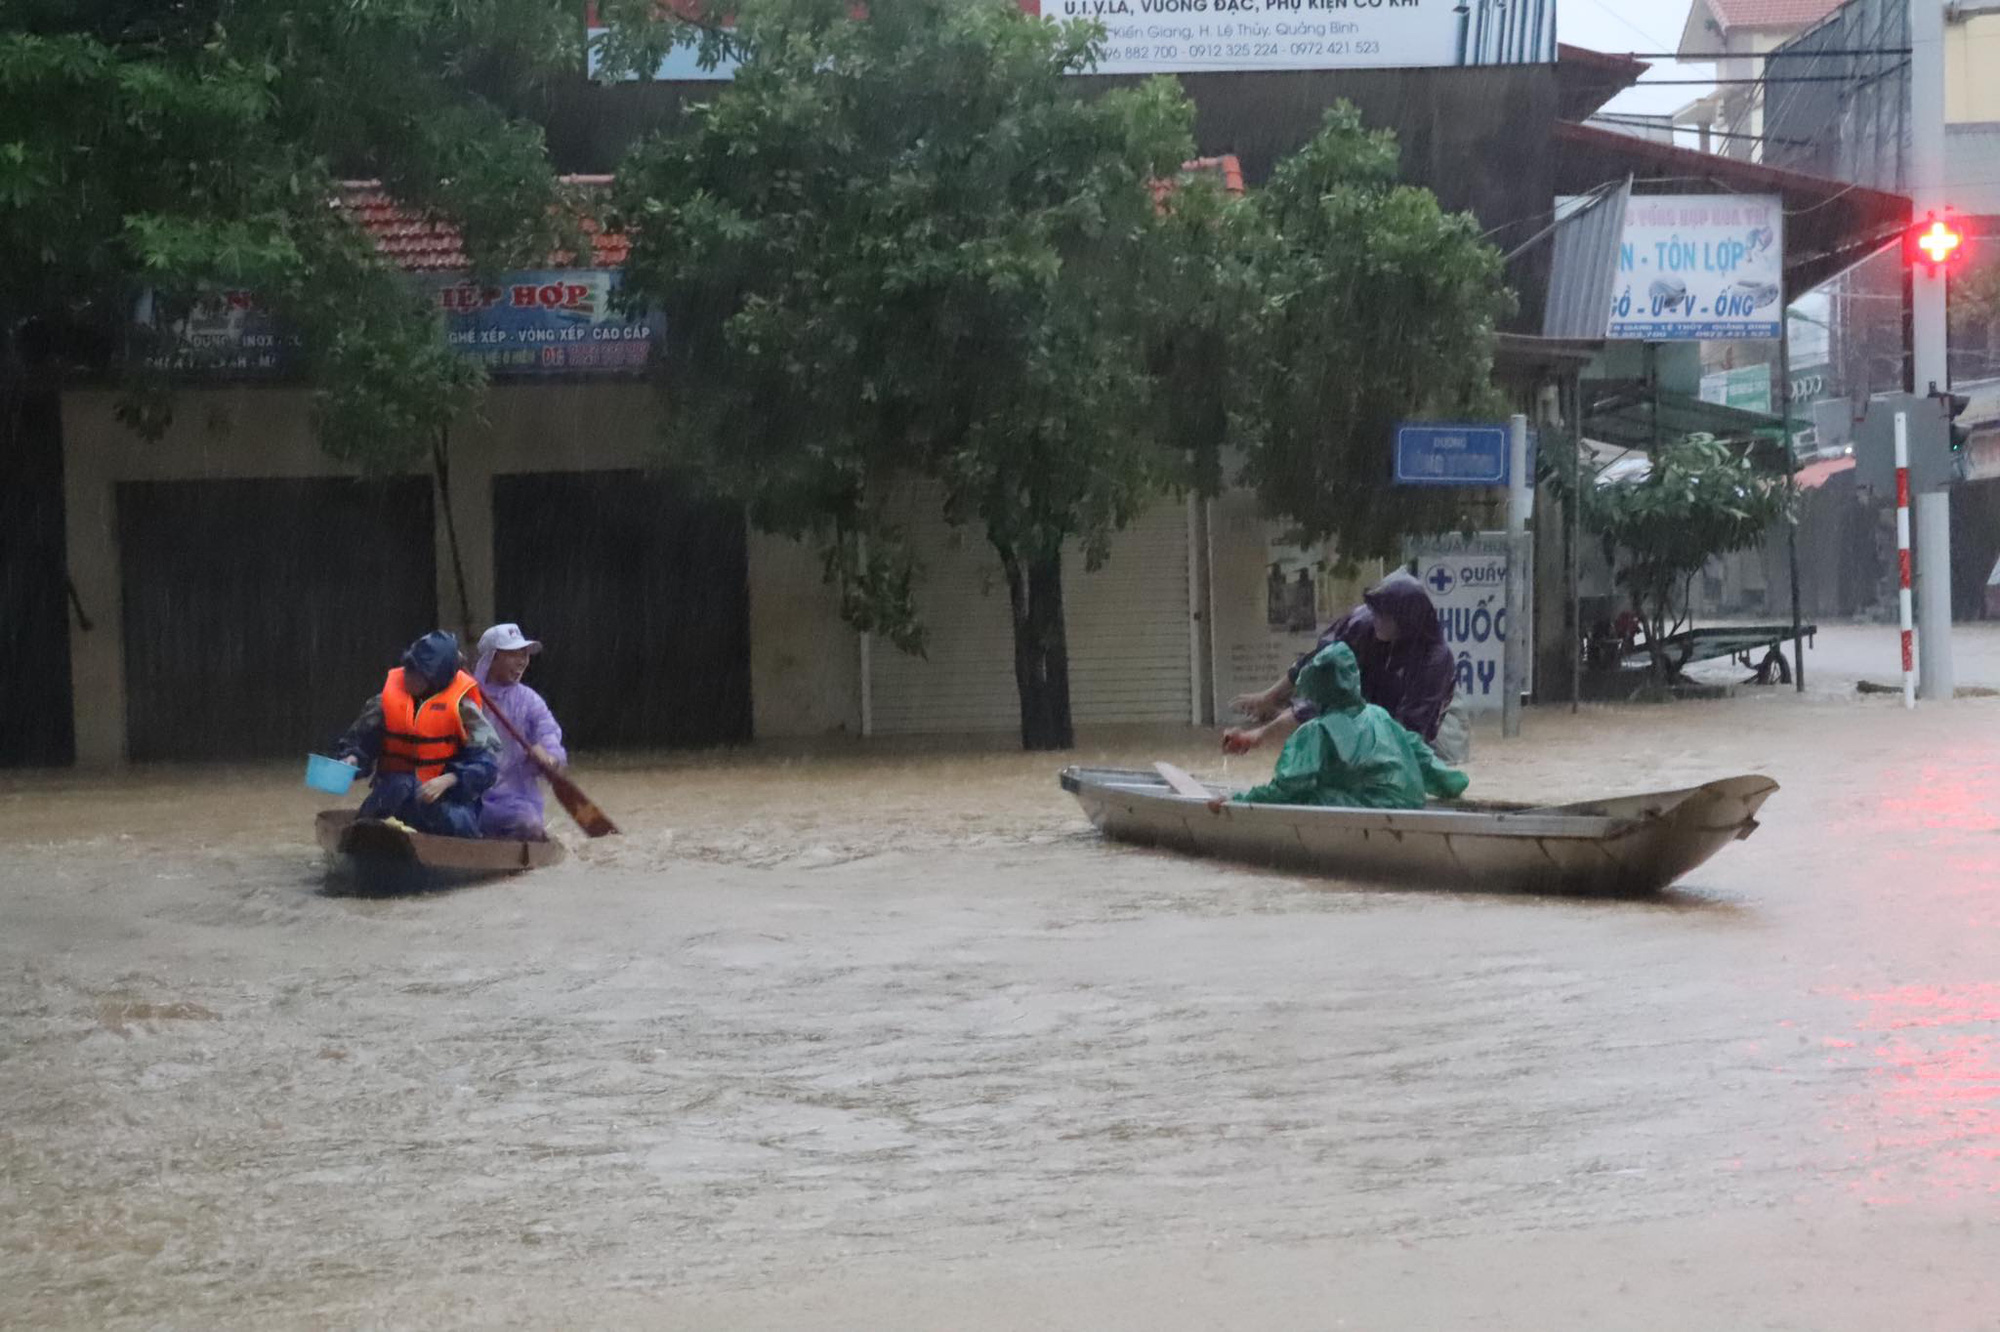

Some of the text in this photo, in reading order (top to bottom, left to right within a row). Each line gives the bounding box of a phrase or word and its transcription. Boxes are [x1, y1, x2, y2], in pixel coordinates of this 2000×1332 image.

[1125, 46, 1149, 59] 882
[1153, 45, 1177, 58] 700
[1188, 44, 1222, 57] 0912
[1225, 43, 1250, 57] 325
[1253, 43, 1279, 56] 224
[1290, 42, 1323, 55] 0972
[1326, 42, 1351, 54] 421
[1355, 41, 1381, 54] 523
[1655, 234, 1696, 272] TÔN
[1703, 236, 1746, 278] LỢP
[440, 281, 590, 315] IỆP HỢP
[1684, 295, 1697, 317] V
[1714, 285, 1754, 318] ỐNG
[592, 327, 621, 341] CAO
[1439, 595, 1507, 642] HUỐC
[1455, 650, 1496, 695] ÂY
